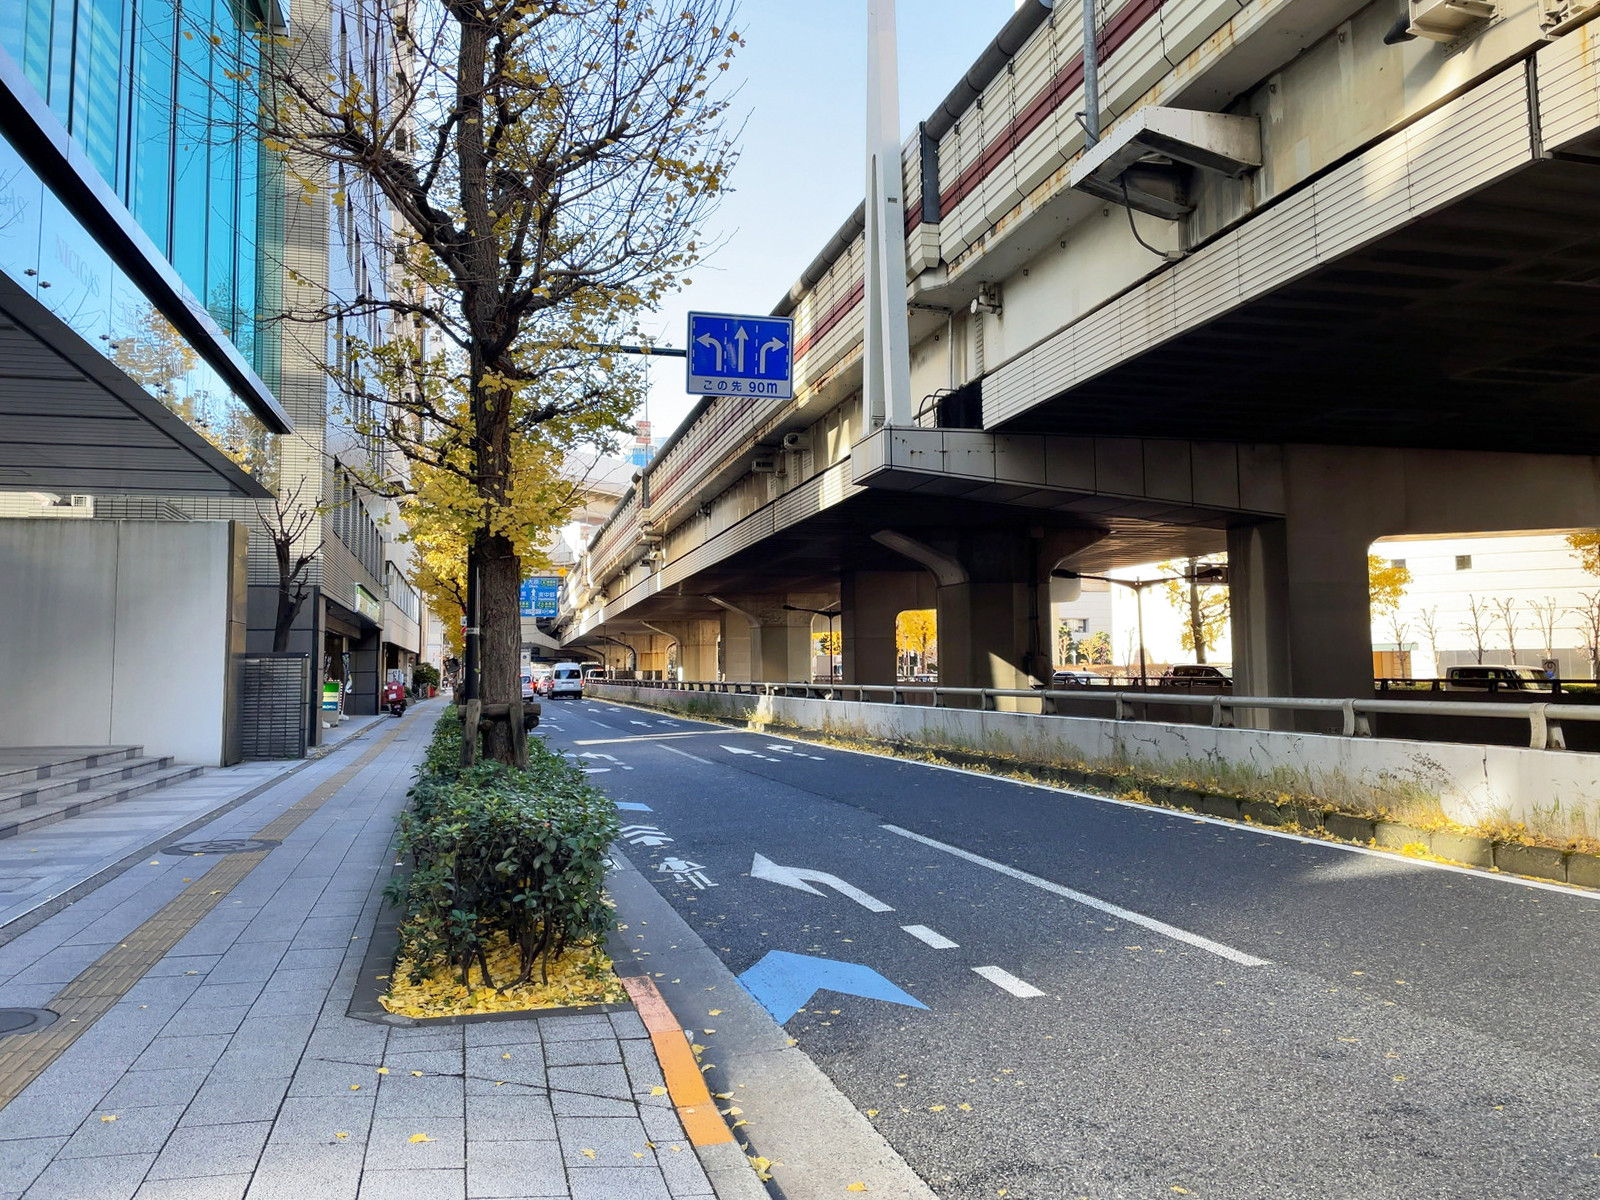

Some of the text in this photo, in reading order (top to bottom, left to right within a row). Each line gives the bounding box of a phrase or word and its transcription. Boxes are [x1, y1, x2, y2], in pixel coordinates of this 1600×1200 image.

[55, 233, 100, 298] NICIGAS
[703, 380, 777, 394] この先 90m
